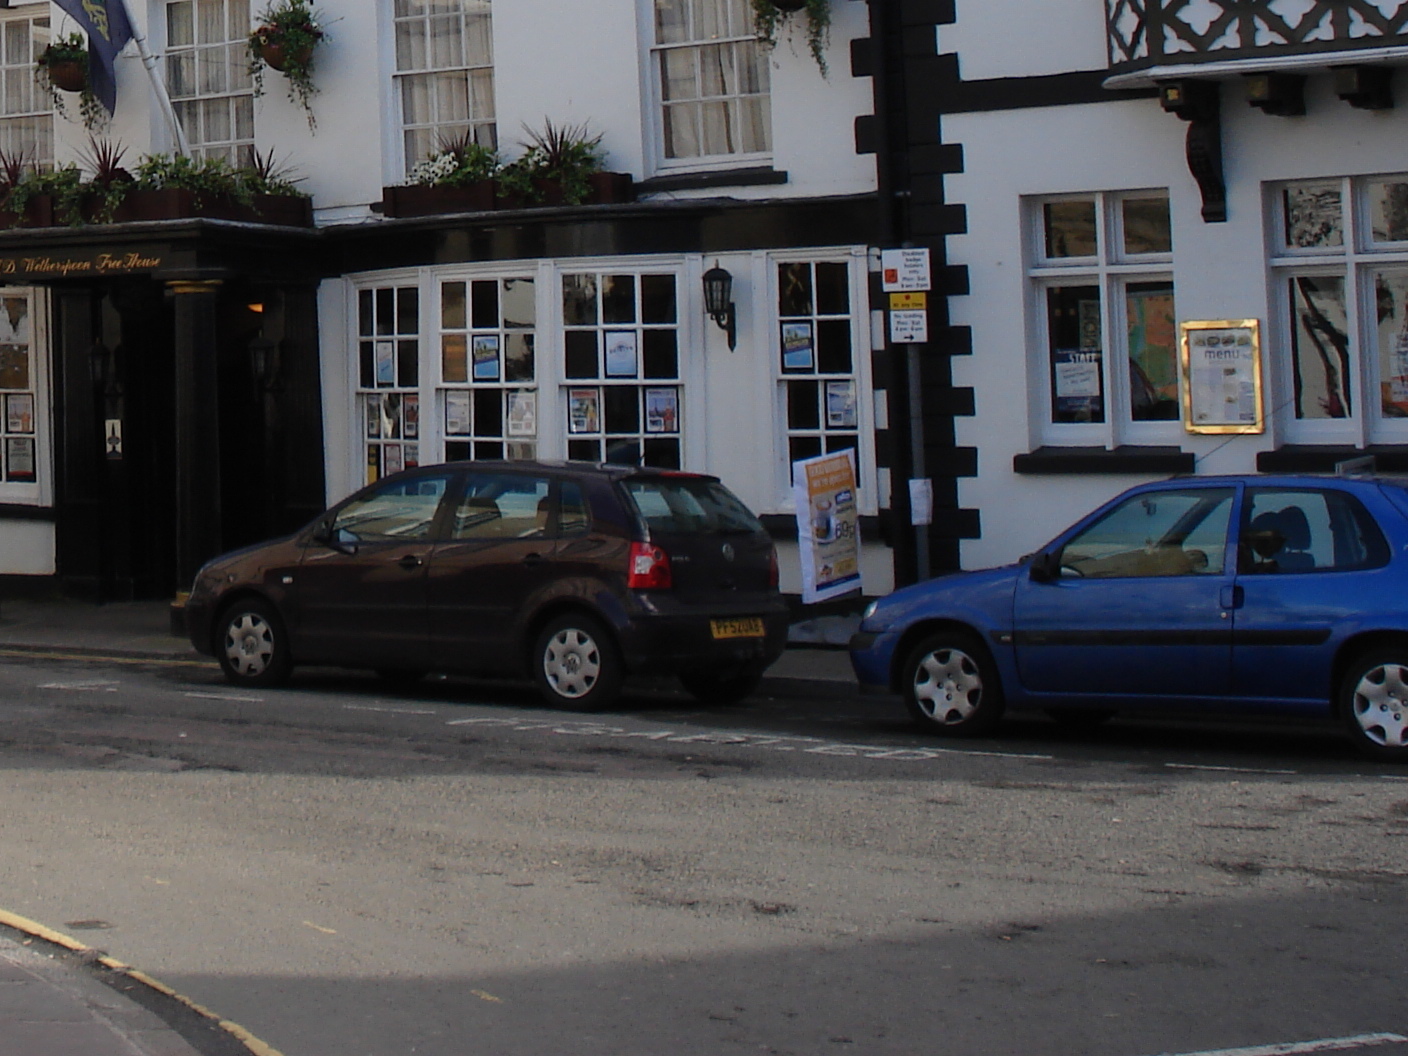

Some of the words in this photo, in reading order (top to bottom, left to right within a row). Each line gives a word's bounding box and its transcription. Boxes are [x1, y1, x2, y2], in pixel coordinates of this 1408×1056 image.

[96, 253, 122, 273] Free
[123, 252, 160, 272] House
[1205, 350, 1240, 359] menu
